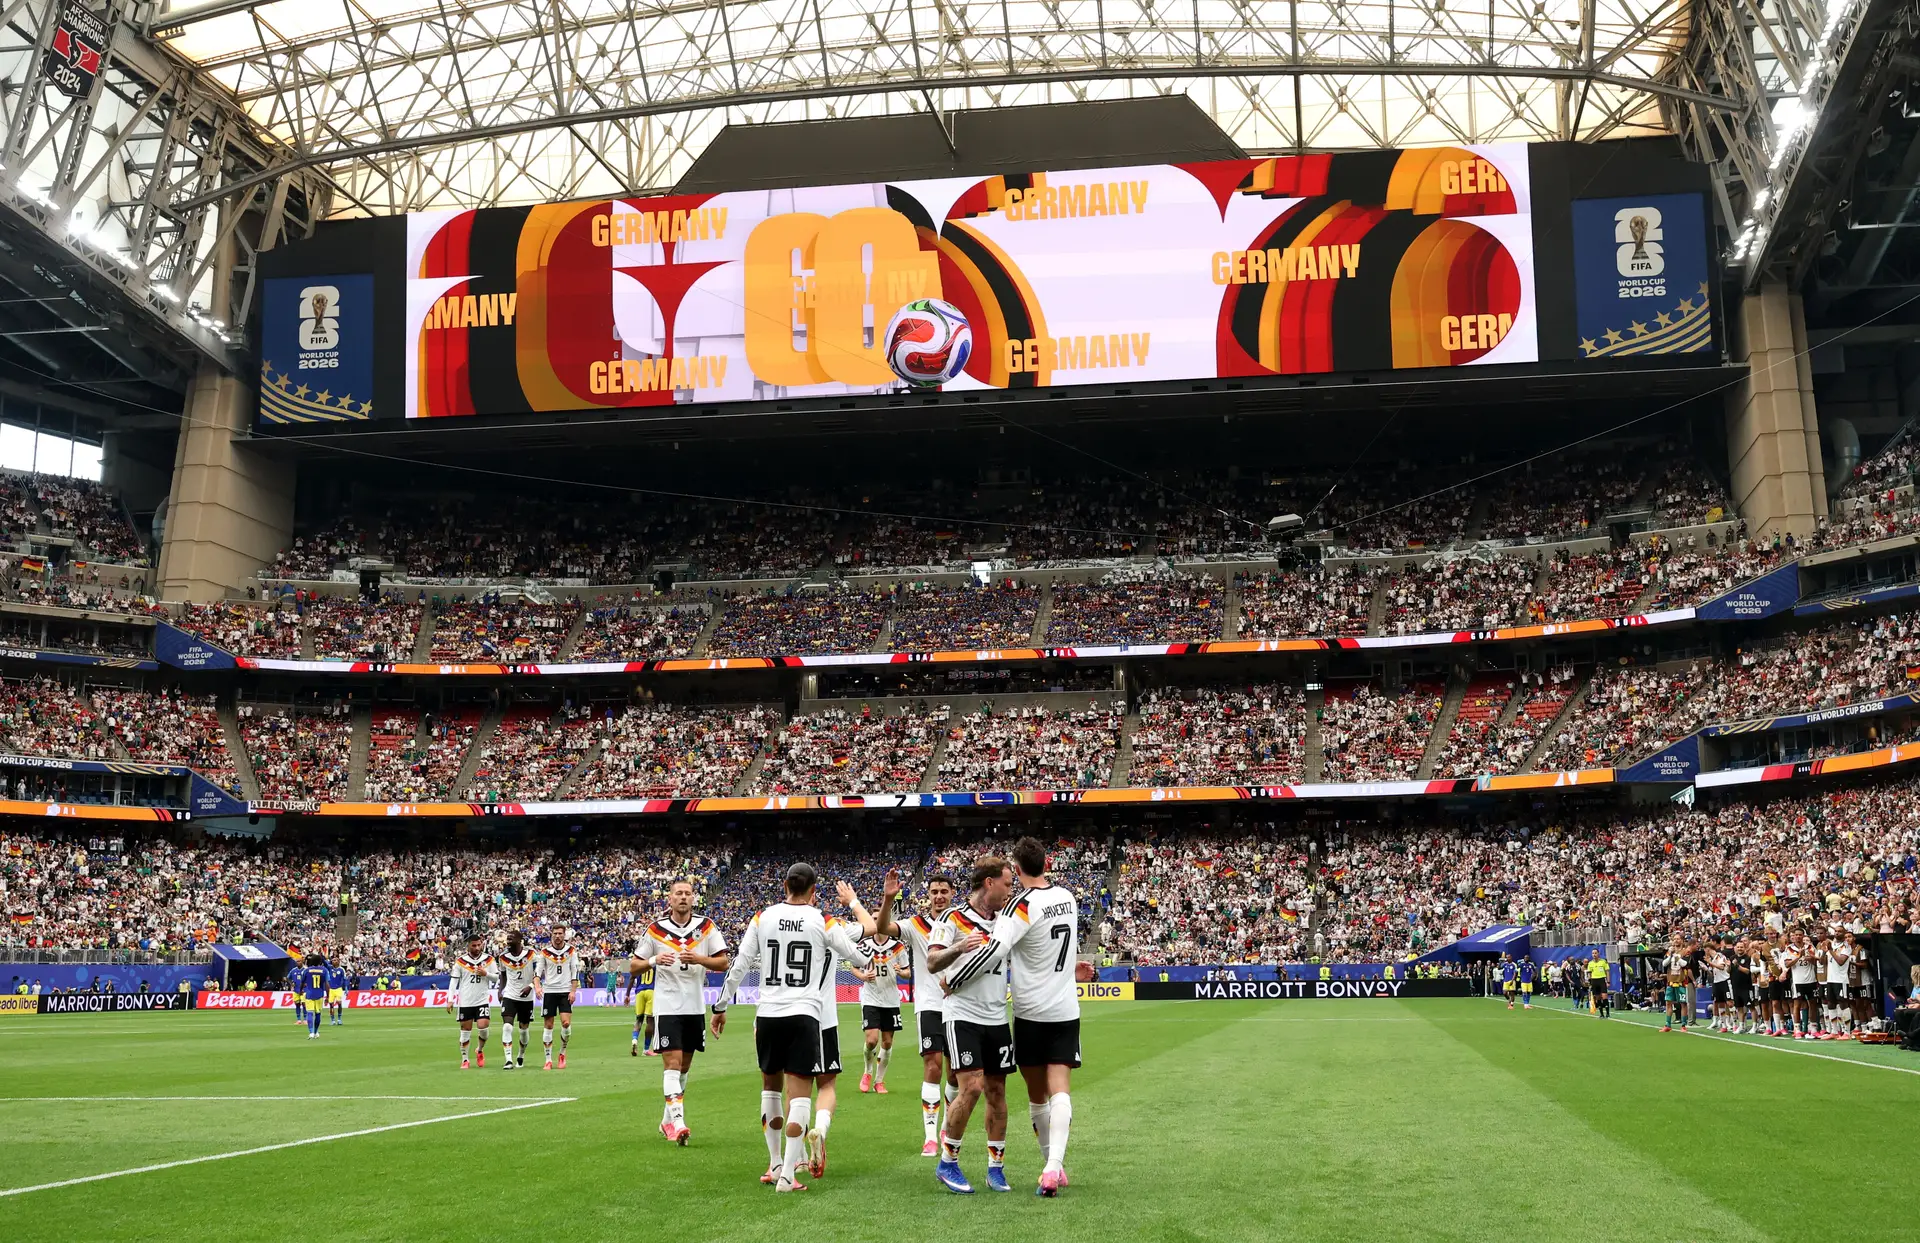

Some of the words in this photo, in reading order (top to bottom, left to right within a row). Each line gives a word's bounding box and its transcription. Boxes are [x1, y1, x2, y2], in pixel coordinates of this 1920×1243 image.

[70, 5, 83, 18] AFC
[82, 14, 103, 33] SOUTH
[63, 10, 105, 46] CHAMPIONS
[53, 64, 81, 93] 2024
[1004, 181, 1149, 222] GERMANY
[592, 207, 728, 247] GERMANY
[1211, 244, 1361, 285] GERMANY
[1630, 262, 1652, 271] FIFA
[1618, 279, 1648, 287] WORLD
[1618, 286, 1667, 298] 2026
[1004, 332, 1150, 373] GERMANY
[298, 359, 339, 369] 2026
[590, 356, 728, 394] GERMANY
[1615, 617, 1642, 627] GOAL
[1470, 631, 1498, 640] GOAL
[7, 650, 37, 659] 2026
[908, 653, 935, 662] GOAL
[1045, 649, 1072, 657] GOAL
[368, 664, 396, 672] GOAL
[508, 665, 535, 673] GOAL
[1806, 714, 1821, 723] FIFA
[1821, 709, 1845, 720] WORLD
[1845, 707, 1860, 716] CUP
[1859, 702, 1884, 713] 2026
[26, 758, 43, 767] CUP
[44, 760, 73, 769] 2026
[1052, 793, 1082, 801] GOAL
[1251, 788, 1282, 797] GOAL
[895, 794, 907, 807] 7
[933, 794, 945, 806] 1
[485, 805, 513, 814] GOAL
[1042, 901, 1073, 920] HAVERTZ
[779, 917, 804, 932] SANÉ
[1050, 923, 1071, 973] 7
[556, 965, 563, 974] 8
[766, 939, 812, 988] 19
[516, 971, 523, 980] 2
[640, 968, 654, 985] 10
[875, 965, 888, 977] 15
[1207, 970, 1237, 981] FA
[470, 974, 481, 984] 26
[1087, 984, 1121, 997] libre
[1195, 981, 1306, 999] MARRIOTT
[1316, 981, 1402, 997] BONVOY
[47, 995, 113, 1012] MARRIOTT
[117, 994, 178, 1010] BONVOY
[205, 992, 264, 1008] Betano
[356, 992, 416, 1007] Betano
[1679, 993, 1686, 1001] 12
[18, 997, 38, 1010] libre
[479, 1007, 490, 1017] 26
